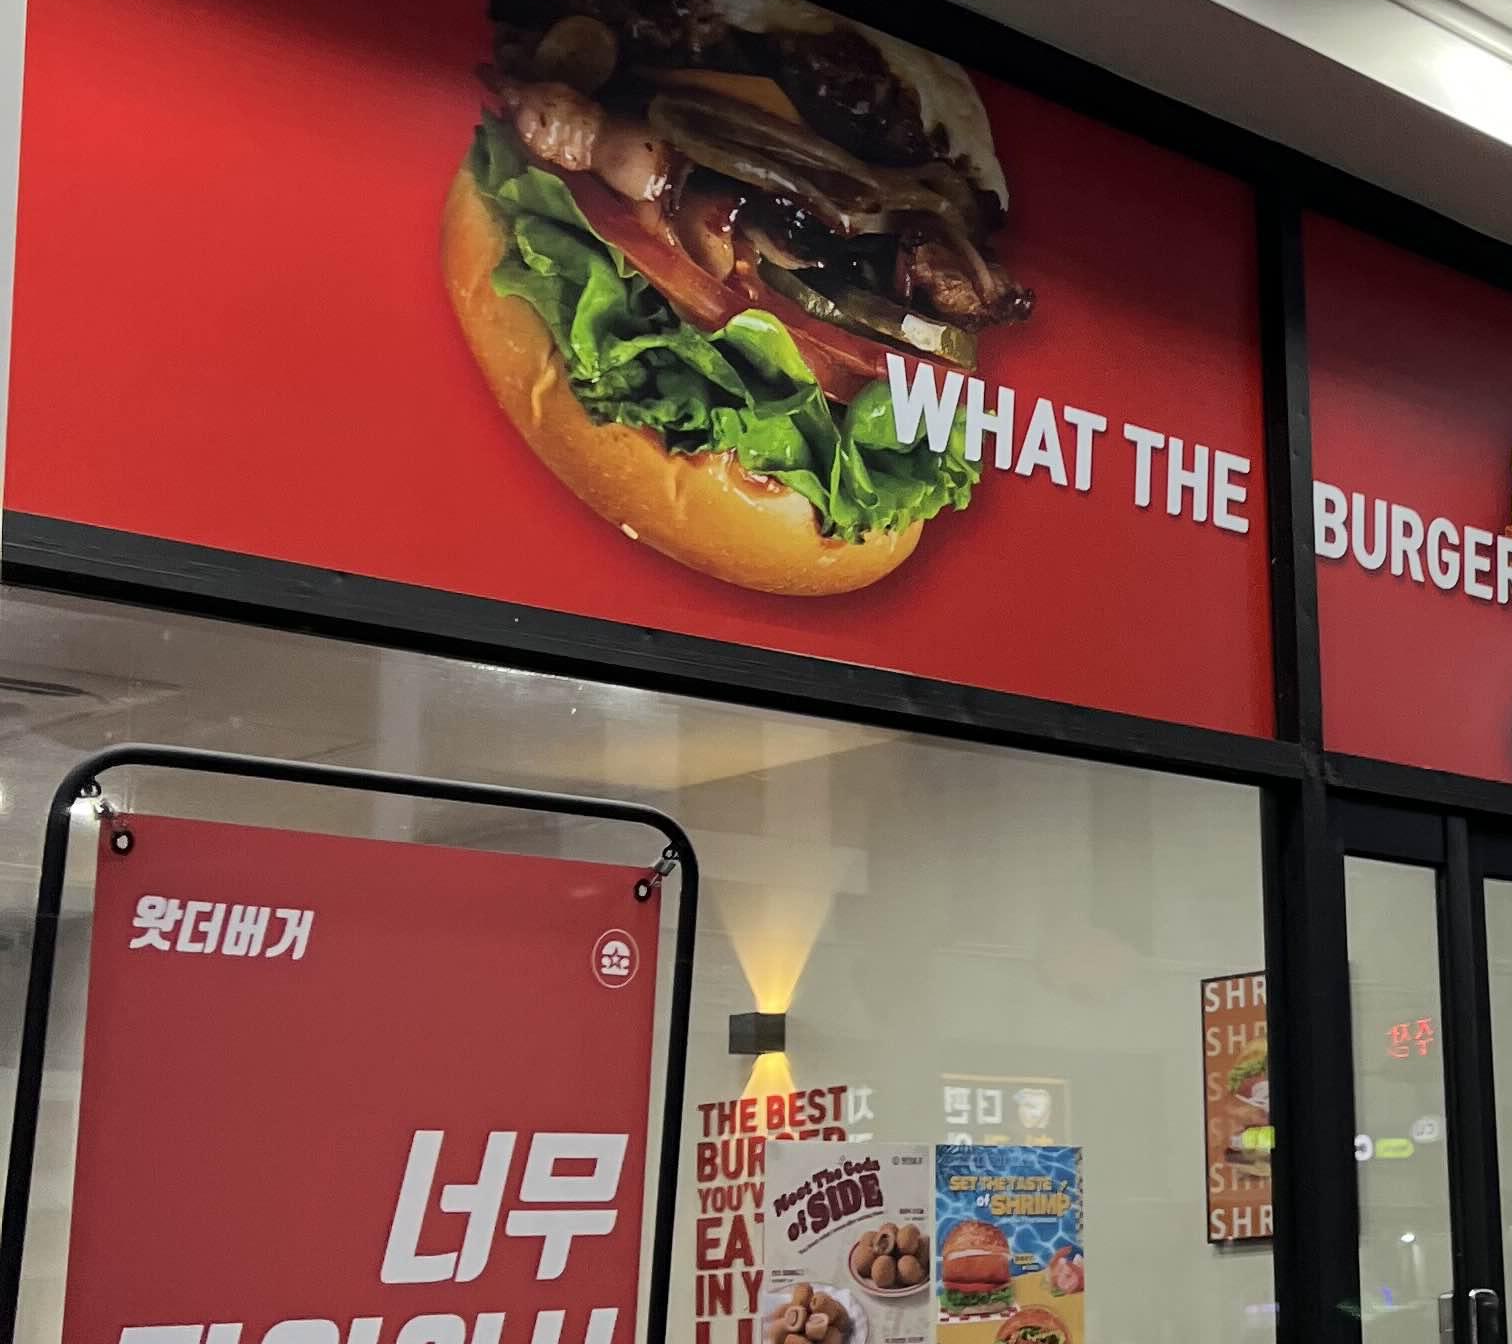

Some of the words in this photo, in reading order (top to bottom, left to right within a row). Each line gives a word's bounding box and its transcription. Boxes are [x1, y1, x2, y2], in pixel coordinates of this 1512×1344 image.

[885, 351, 1109, 492] WHAT
[1123, 422, 1252, 534] THE
[128, 894, 315, 962] 왓더버거
[698, 1097, 757, 1138] THE
[766, 1085, 848, 1131] BEST
[380, 1128, 631, 1286] 너무
[787, 1209, 808, 1242] of
[806, 1171, 884, 1234] SIDE
[976, 1193, 990, 1208] of
[990, 1192, 1073, 1218] SHRIMP
[696, 1271, 733, 1317] IN
